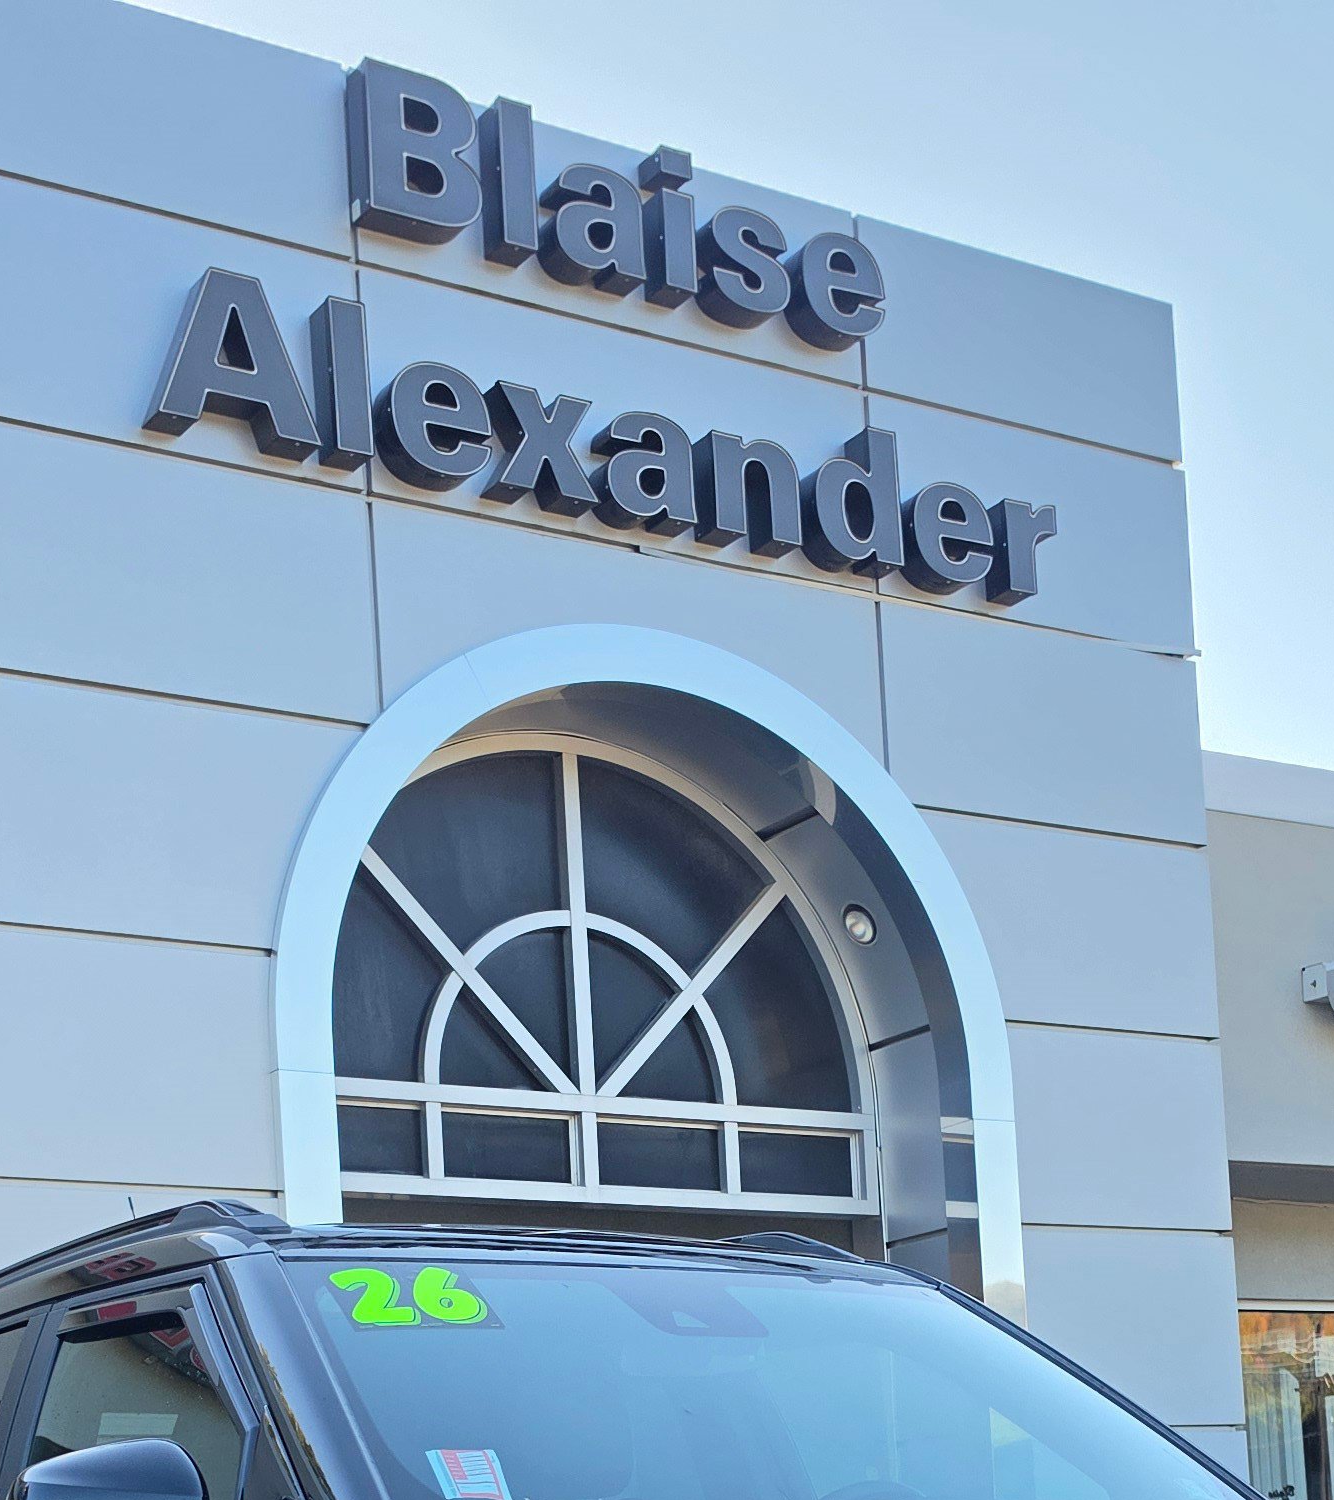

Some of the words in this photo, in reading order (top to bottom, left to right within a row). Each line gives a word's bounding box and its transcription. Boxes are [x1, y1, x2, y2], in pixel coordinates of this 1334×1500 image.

[347, 57, 885, 351] Blaise
[143, 266, 1056, 605] Alexander
[329, 1266, 488, 1326] 26
